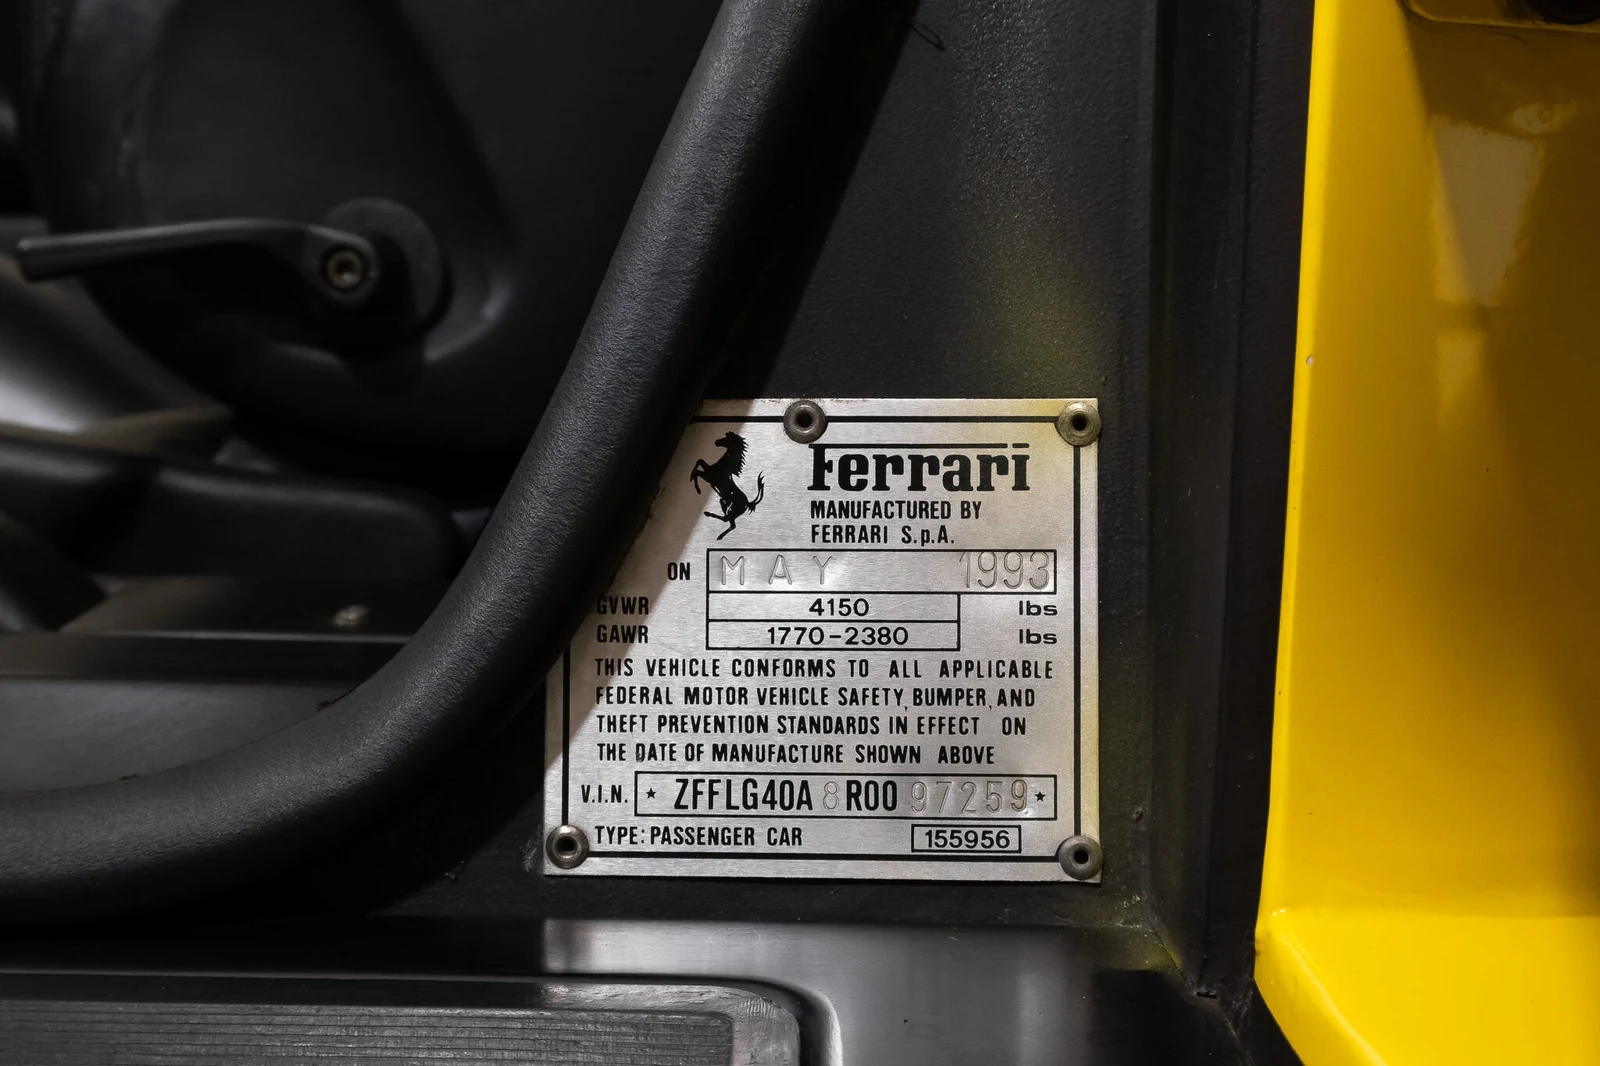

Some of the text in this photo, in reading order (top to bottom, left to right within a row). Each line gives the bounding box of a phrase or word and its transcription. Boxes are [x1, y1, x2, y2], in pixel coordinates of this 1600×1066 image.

[807, 442, 1030, 491] Ferrari
[810, 500, 981, 519] MANUFACTURED BY
[811, 525, 955, 546] FERRARI S.p.A.
[667, 562, 691, 581] ON
[959, 550, 1051, 590] 1993
[597, 596, 1058, 616] GVWR 4150 lbs
[597, 624, 1058, 645] GAWR 1770-2380 lbs
[595, 658, 1053, 679] THIS VEHICLE CONFORMS TO ALL APPLICABLE
[596, 686, 673, 705] FEDERAL
[684, 687, 748, 705] MOTOR
[757, 687, 828, 706] VEHICLE
[997, 689, 1035, 707] AND
[597, 715, 1026, 735] THEFT PREVENTION STANDARDS IN EFFECT ON
[597, 743, 995, 764] THE DATE OF MANUFACTURE SHOWN ABOVE
[581, 784, 628, 803] V.I.N.
[767, 827, 802, 846] CAR
[925, 829, 1011, 849] 155956
